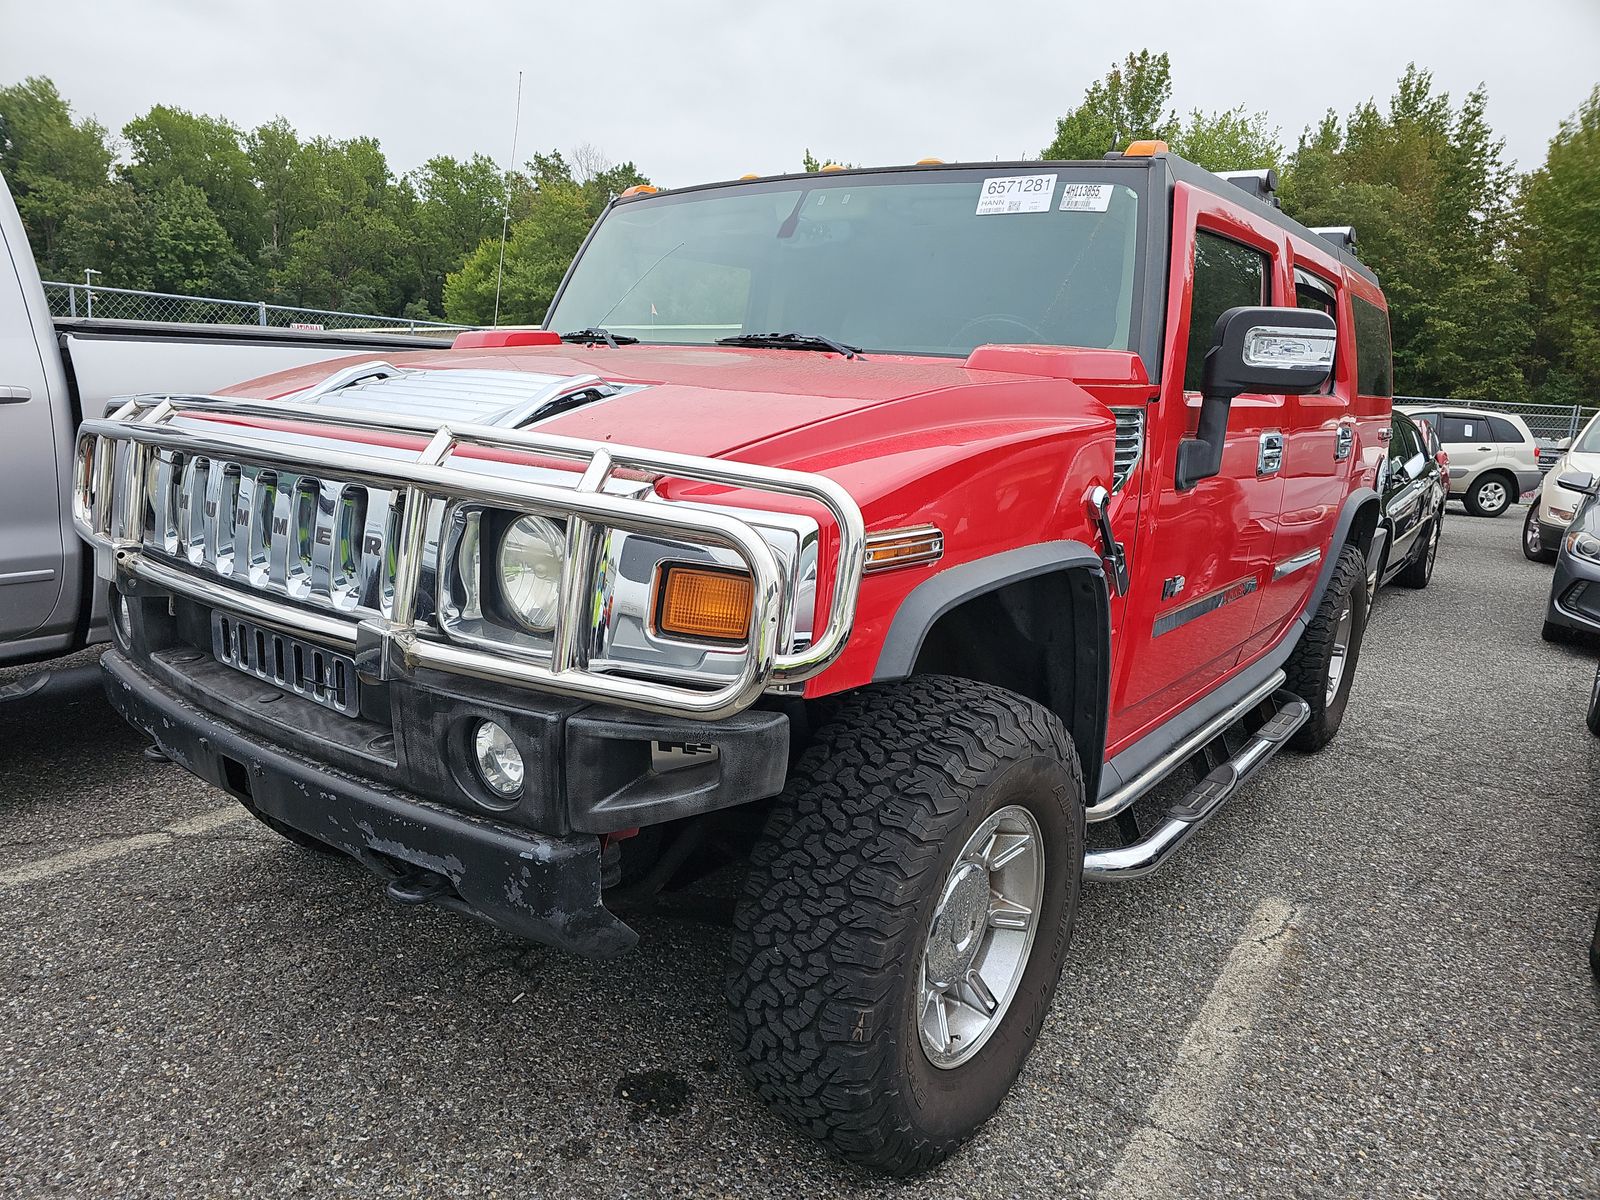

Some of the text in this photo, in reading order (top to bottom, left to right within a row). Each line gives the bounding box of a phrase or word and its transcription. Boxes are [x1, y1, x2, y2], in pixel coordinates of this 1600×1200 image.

[987, 178, 1051, 194] 6571281
[1066, 185, 1101, 197] 4H113855
[179, 494, 382, 557] HUMMER
[1160, 574, 1186, 601] H2
